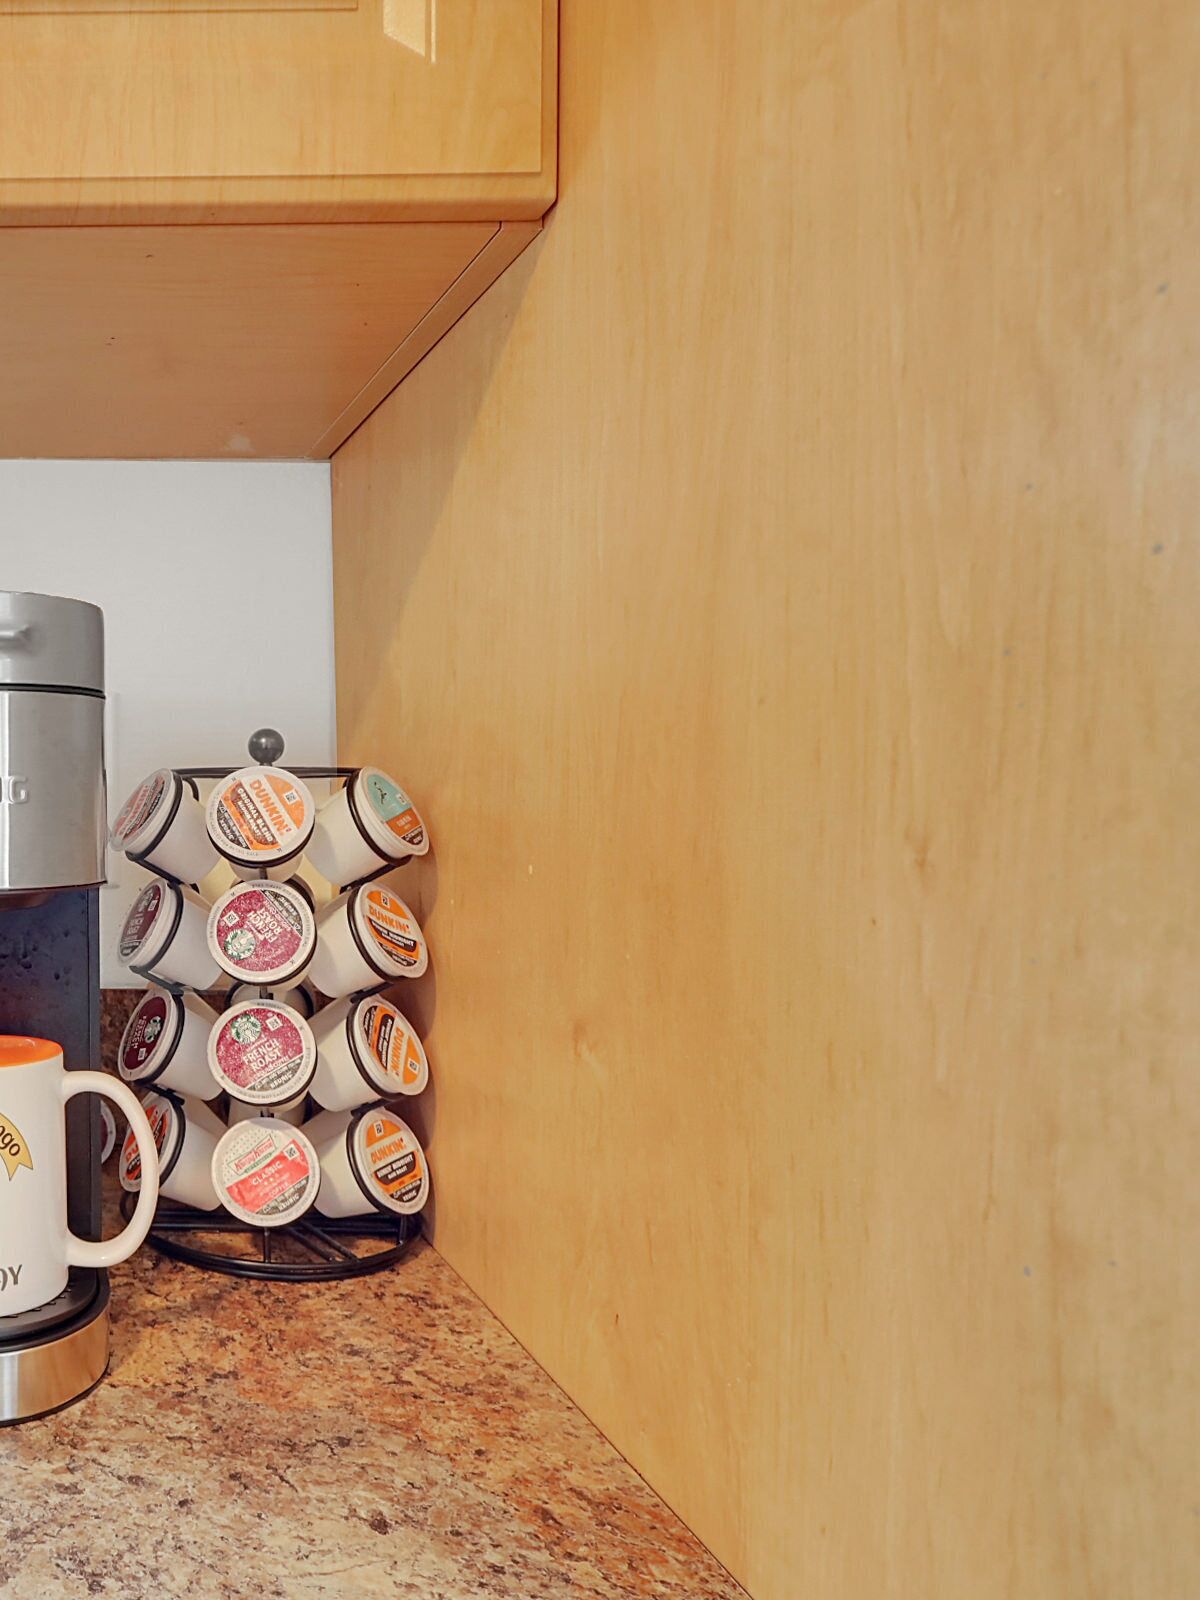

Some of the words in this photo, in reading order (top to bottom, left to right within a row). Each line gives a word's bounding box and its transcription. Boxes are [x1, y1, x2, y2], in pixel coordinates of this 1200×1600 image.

[236, 787, 259, 819] ORIGINAL
[255, 817, 274, 842] BLEND
[247, 910, 277, 942] FRENCH
[256, 907, 283, 934] ROAST
[242, 1037, 279, 1064] FRENCH
[249, 1047, 281, 1071] ROAST
[250, 1161, 283, 1186] CLASSIC
